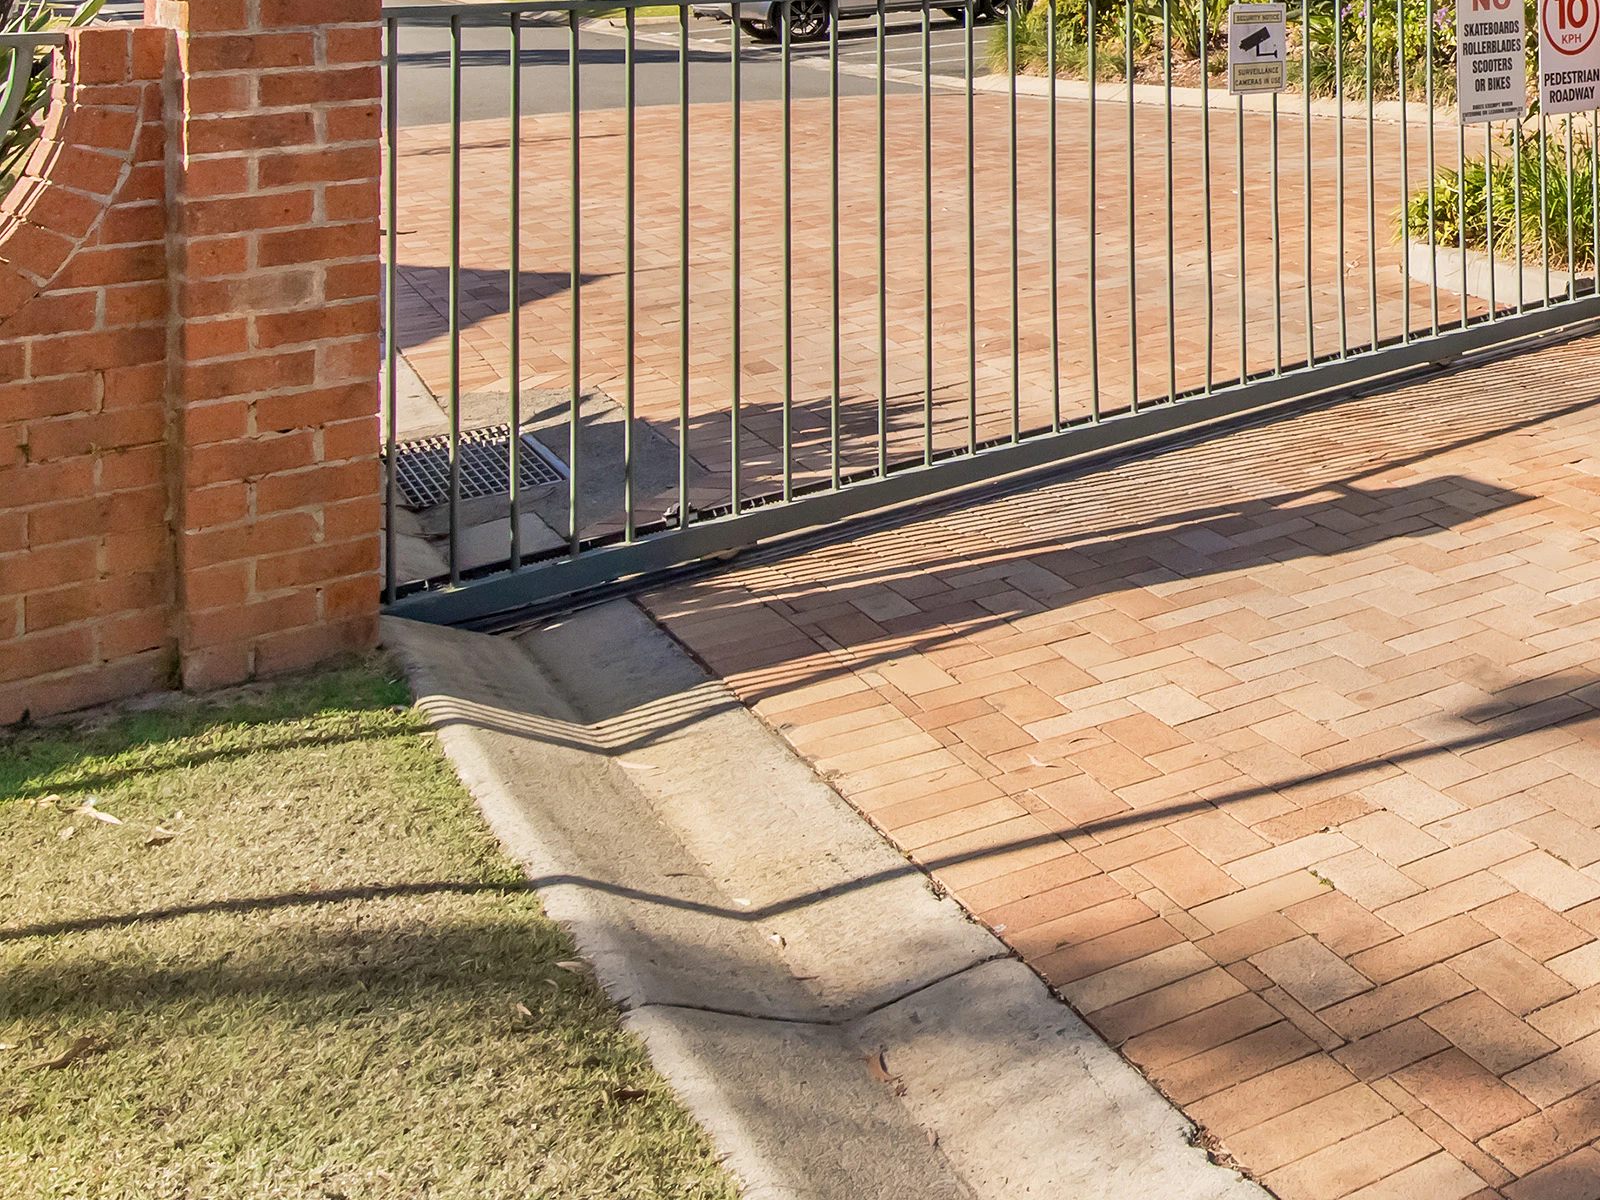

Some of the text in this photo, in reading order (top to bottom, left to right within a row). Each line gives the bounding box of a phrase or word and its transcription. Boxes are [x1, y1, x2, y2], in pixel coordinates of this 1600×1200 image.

[1262, 13, 1280, 21] NOTICE
[1463, 20, 1520, 37] SKATEBOARDS
[1462, 38, 1522, 56] ROLLERBLADES
[1561, 33, 1582, 44] KPH
[1237, 66, 1279, 76] SURVEILLANCE
[1472, 57, 1513, 74] SCOOTERS
[1235, 78, 1262, 86] CAMERAS
[1270, 76, 1281, 84] USE
[1474, 75, 1511, 92] OR BIKES
[1544, 68, 1600, 87] PEDESTRIAN
[1549, 86, 1595, 104] ROADWAY
